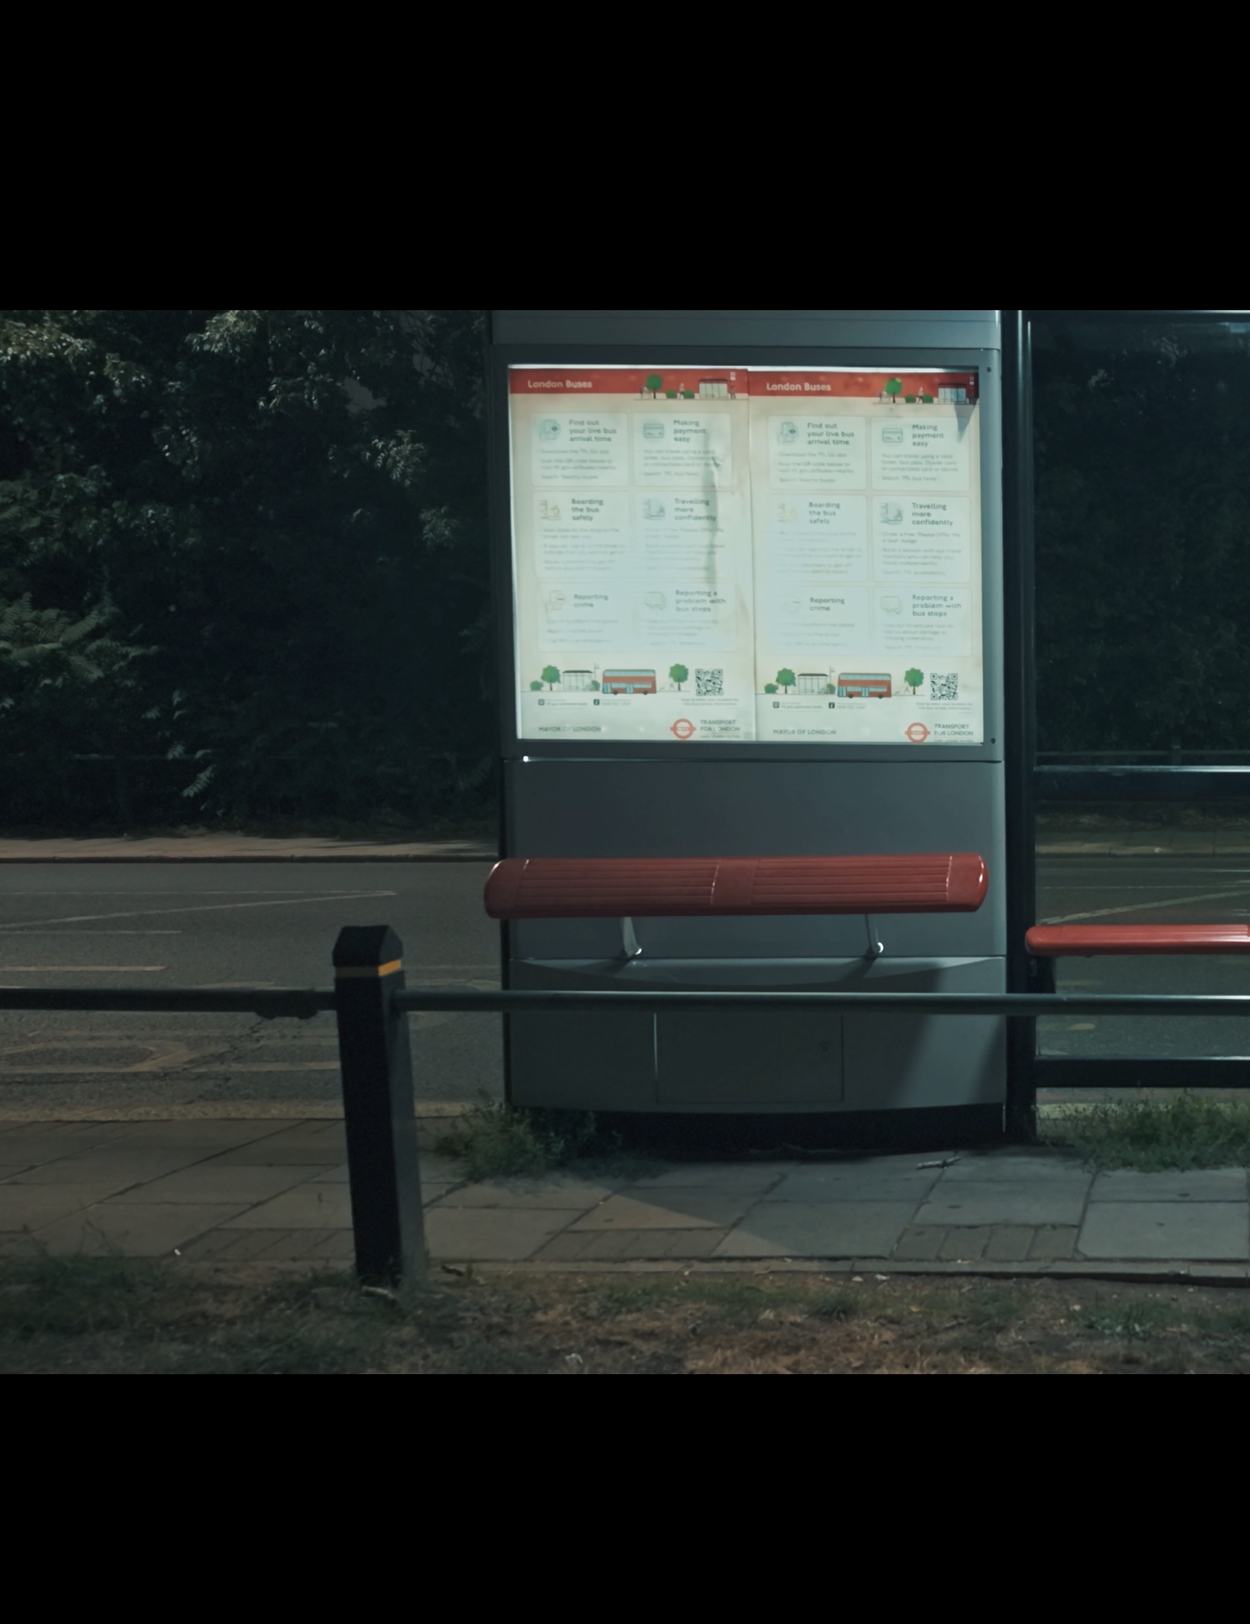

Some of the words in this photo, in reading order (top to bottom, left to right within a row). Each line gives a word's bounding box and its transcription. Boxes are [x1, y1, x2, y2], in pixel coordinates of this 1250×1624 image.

[528, 380, 564, 389] London
[565, 380, 593, 389] Buses
[766, 382, 802, 392] London
[804, 382, 832, 392] Buses
[673, 419, 700, 428] Making
[673, 428, 707, 436] payment
[912, 424, 938, 432] Making
[912, 432, 945, 440] payment
[571, 498, 604, 506] Boarding
[674, 498, 710, 507] Travelling
[809, 502, 841, 510] Boarding
[912, 503, 947, 511] Travelling
[572, 514, 594, 522] safely
[674, 514, 717, 522] confidently
[809, 518, 830, 526] safely
[912, 519, 954, 527] confidently
[574, 593, 609, 602] Reporting
[675, 589, 712, 598] Reporting
[810, 597, 845, 605] Reporting
[912, 594, 948, 602] Reporting
[691, 606, 712, 614] stops
[912, 602, 944, 610] problem
[912, 610, 925, 618] bus
